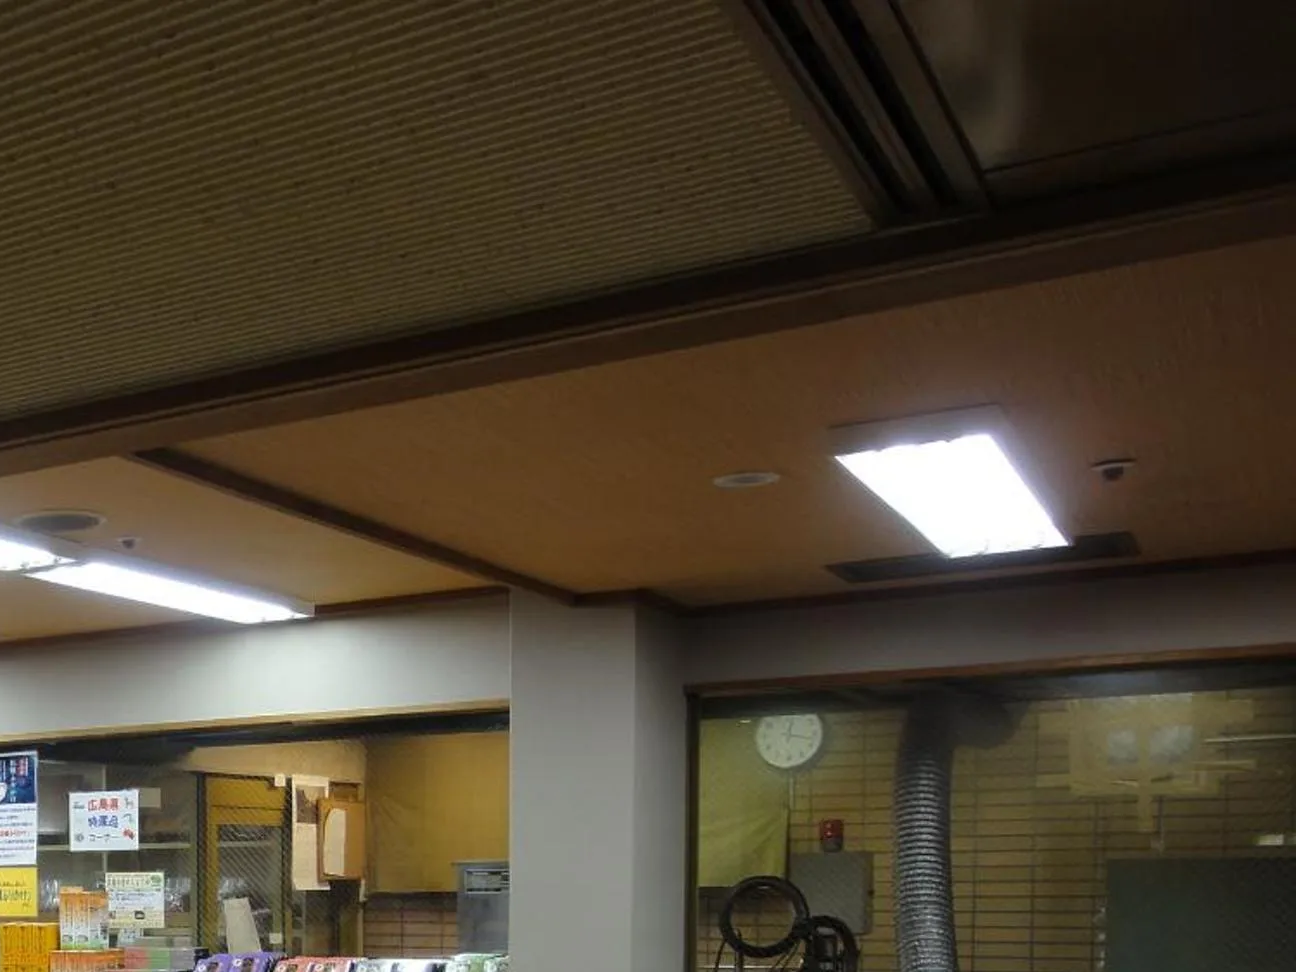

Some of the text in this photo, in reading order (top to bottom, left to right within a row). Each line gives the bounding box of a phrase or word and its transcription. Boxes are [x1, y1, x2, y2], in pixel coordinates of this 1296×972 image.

[87, 798, 119, 812] 広島県
[88, 834, 120, 842] コーナー
